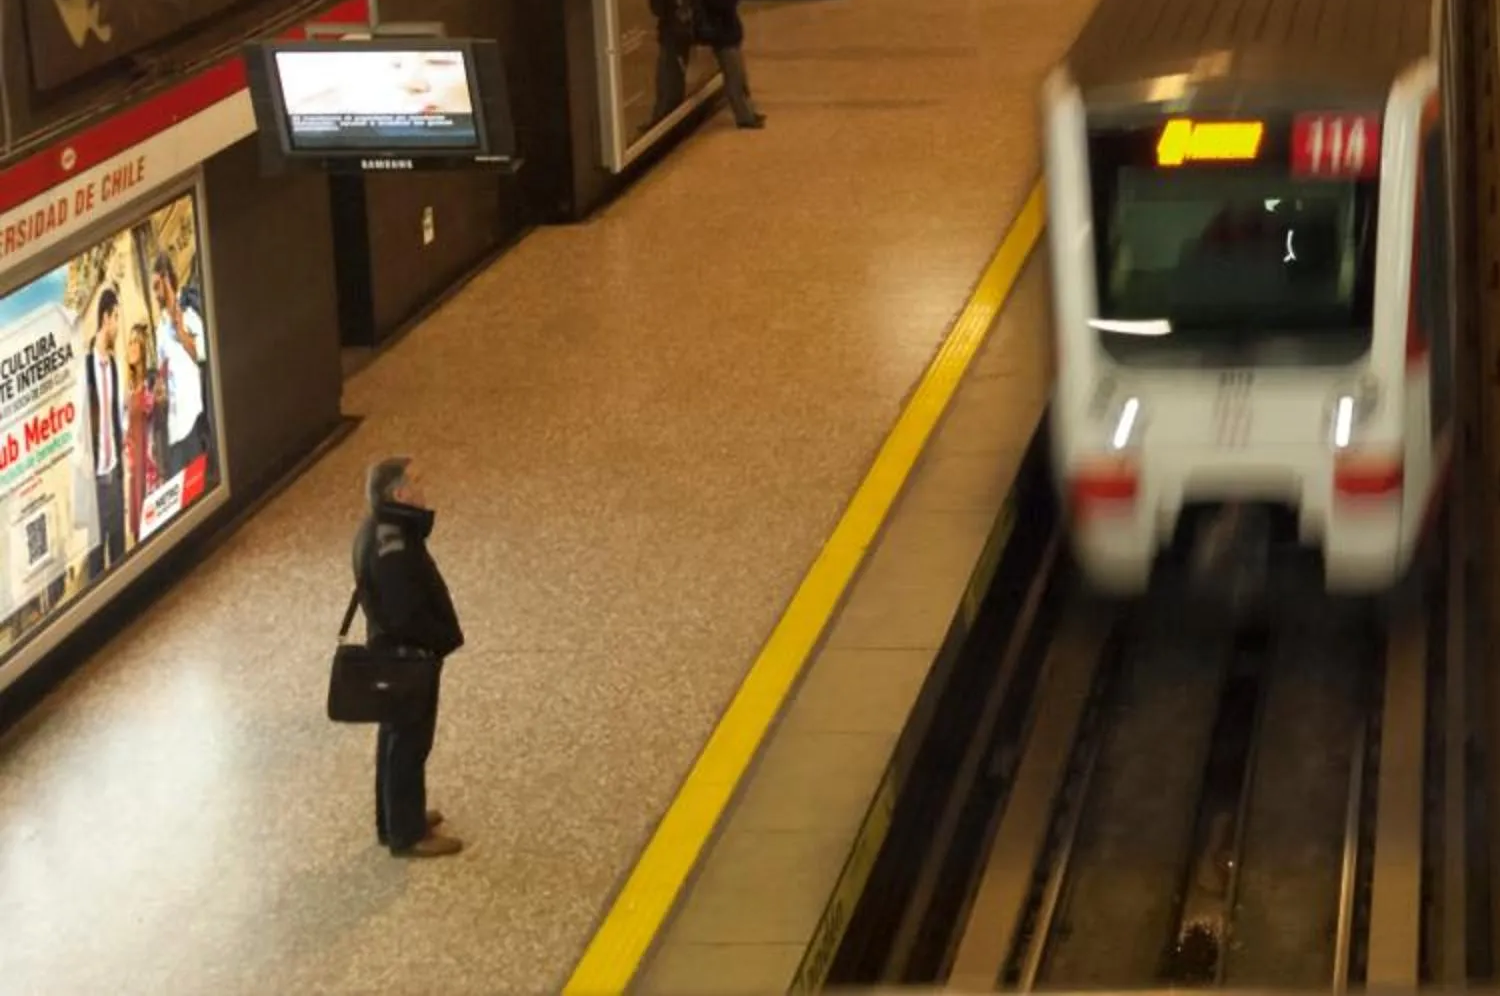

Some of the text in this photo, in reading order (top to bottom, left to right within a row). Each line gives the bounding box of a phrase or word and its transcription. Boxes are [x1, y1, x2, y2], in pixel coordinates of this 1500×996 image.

[360, 159, 413, 170] SAMSUNG
[0, 155, 146, 254] RSIDAD DE CHILE
[1, 331, 57, 380] CULTURA
[16, 342, 74, 393] INTERESA
[24, 401, 75, 453] Metro
